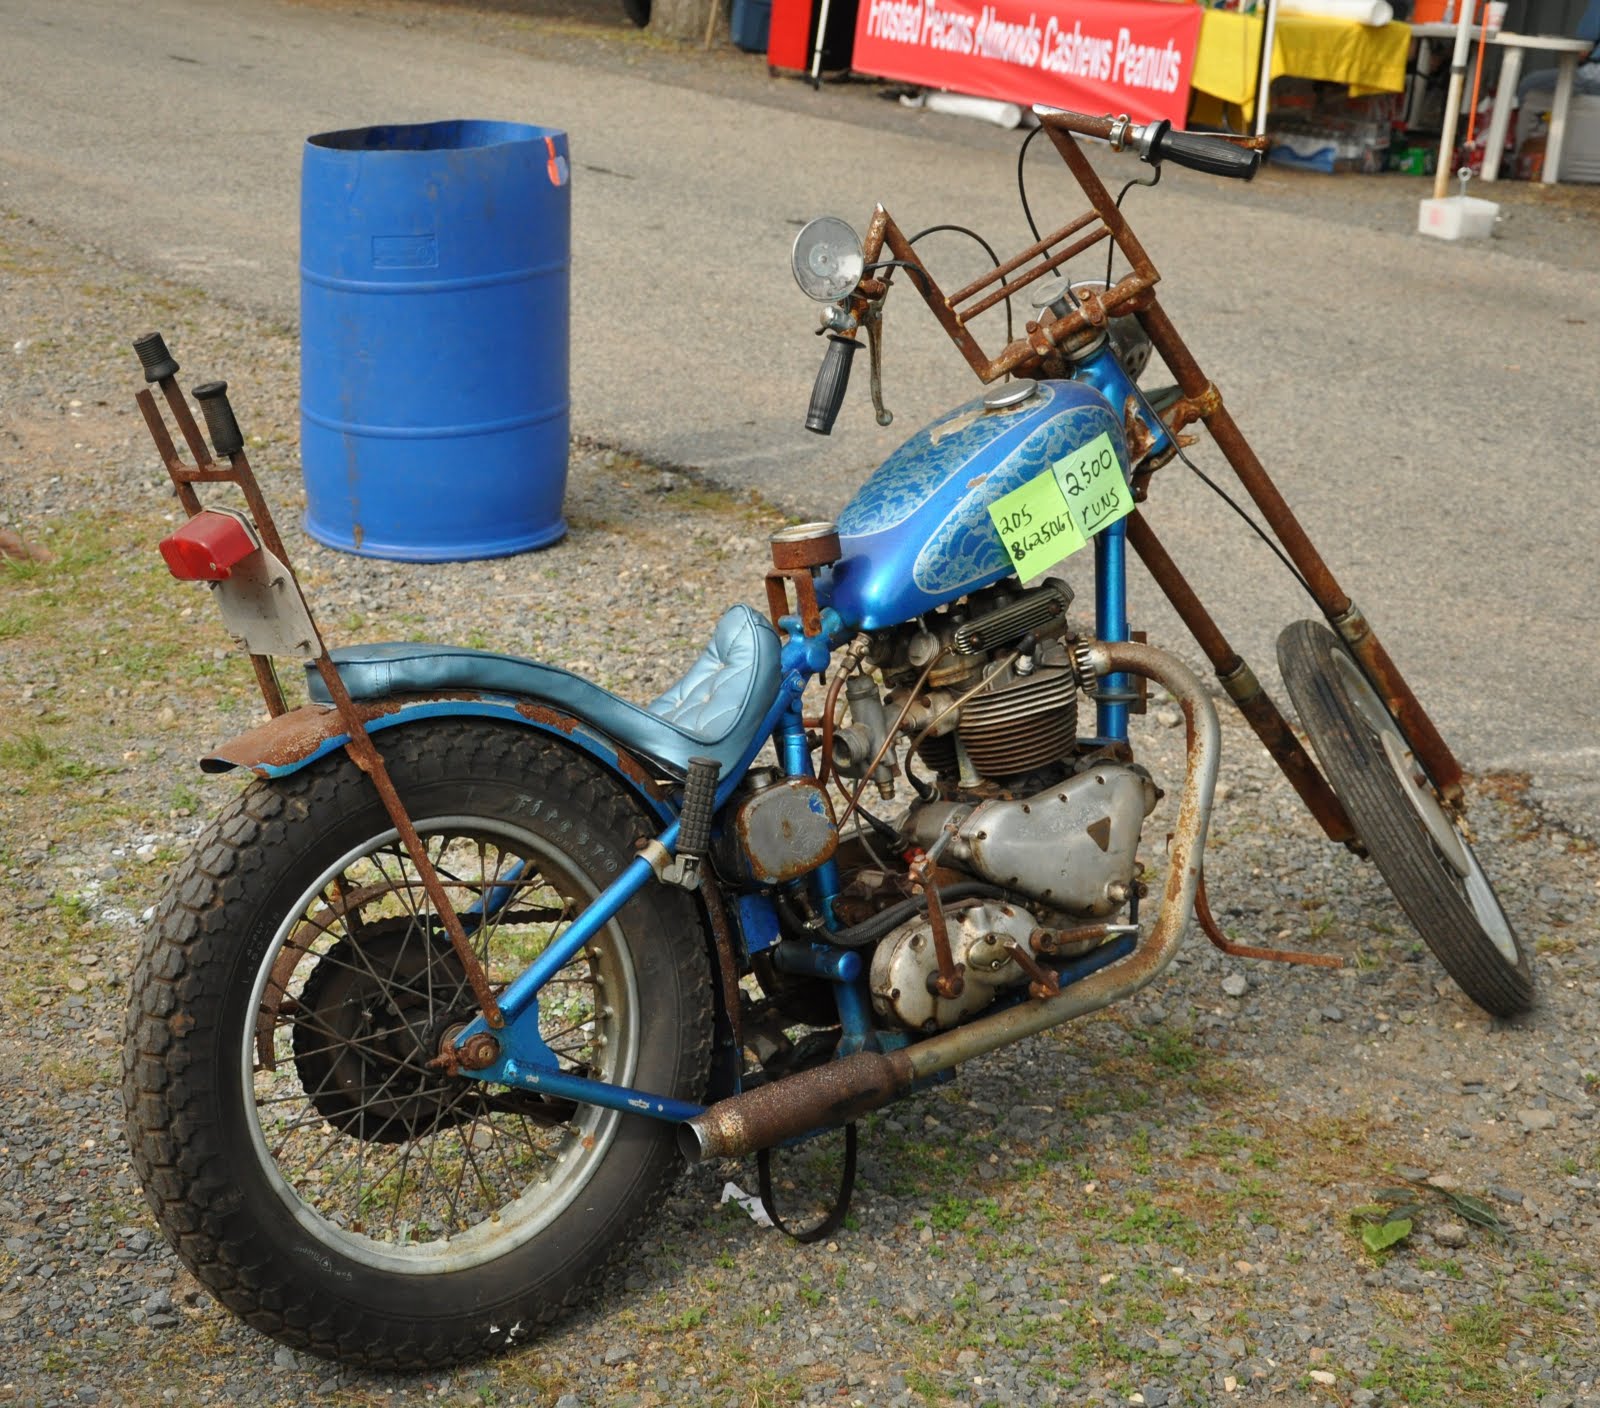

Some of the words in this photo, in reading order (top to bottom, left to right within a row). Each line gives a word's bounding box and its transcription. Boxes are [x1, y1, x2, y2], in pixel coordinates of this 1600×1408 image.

[866, 0, 923, 44] Frosted
[921, 0, 975, 55] Pecans
[973, 5, 1042, 68] Almonds
[1041, 15, 1114, 81] Cashews
[1112, 27, 1181, 93] Peanuts
[1065, 449, 1112, 496] 2500
[1000, 503, 1032, 535] 205
